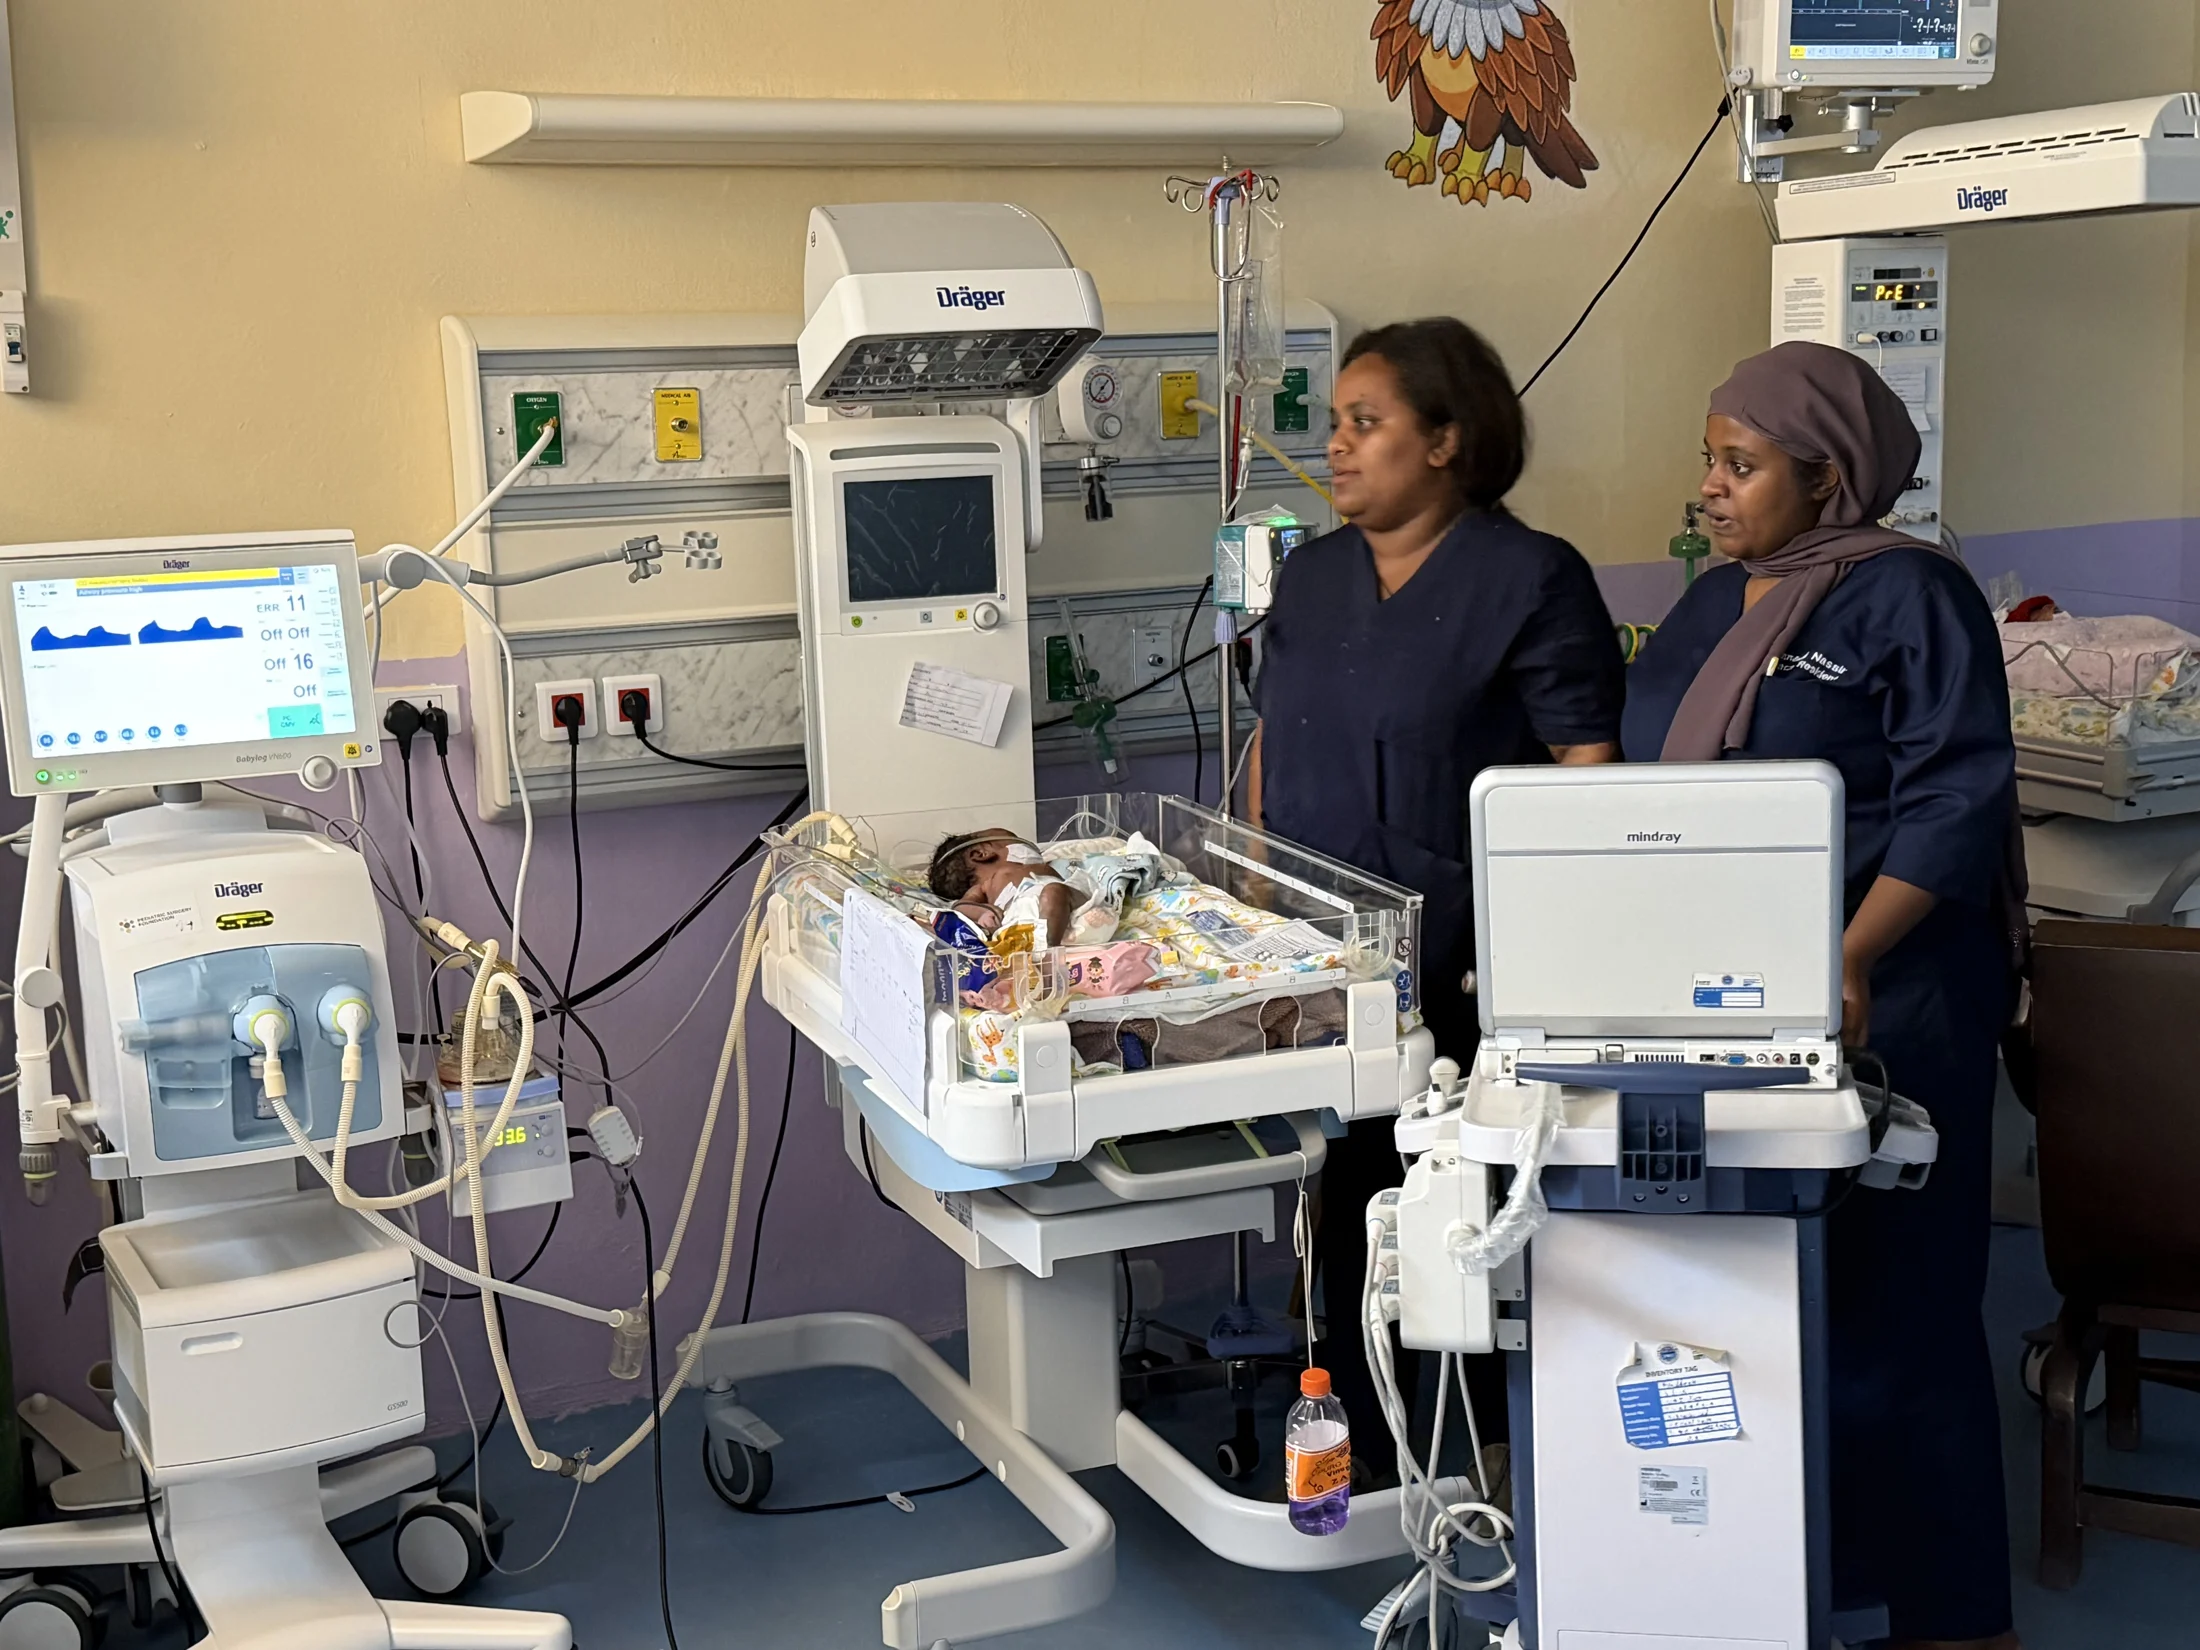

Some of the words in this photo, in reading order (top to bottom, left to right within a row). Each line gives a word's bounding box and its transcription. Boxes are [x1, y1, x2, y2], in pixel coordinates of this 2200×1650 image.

[1957, 185, 2008, 212] Dräger
[936, 286, 1005, 310] Dräger
[163, 560, 190, 569] Dräger
[257, 604, 280, 613] ERR
[287, 594, 306, 612] 11
[261, 629, 282, 641] Off
[288, 627, 310, 639] Off
[264, 658, 286, 671] Off
[294, 653, 314, 670] 16
[293, 684, 317, 698] Off
[236, 755, 268, 764] Babylog
[1627, 831, 1682, 844] mindray
[214, 882, 264, 898] Dräger
[1645, 1368, 1683, 1378] INVENTORY
[1685, 1365, 1699, 1373] TAG
